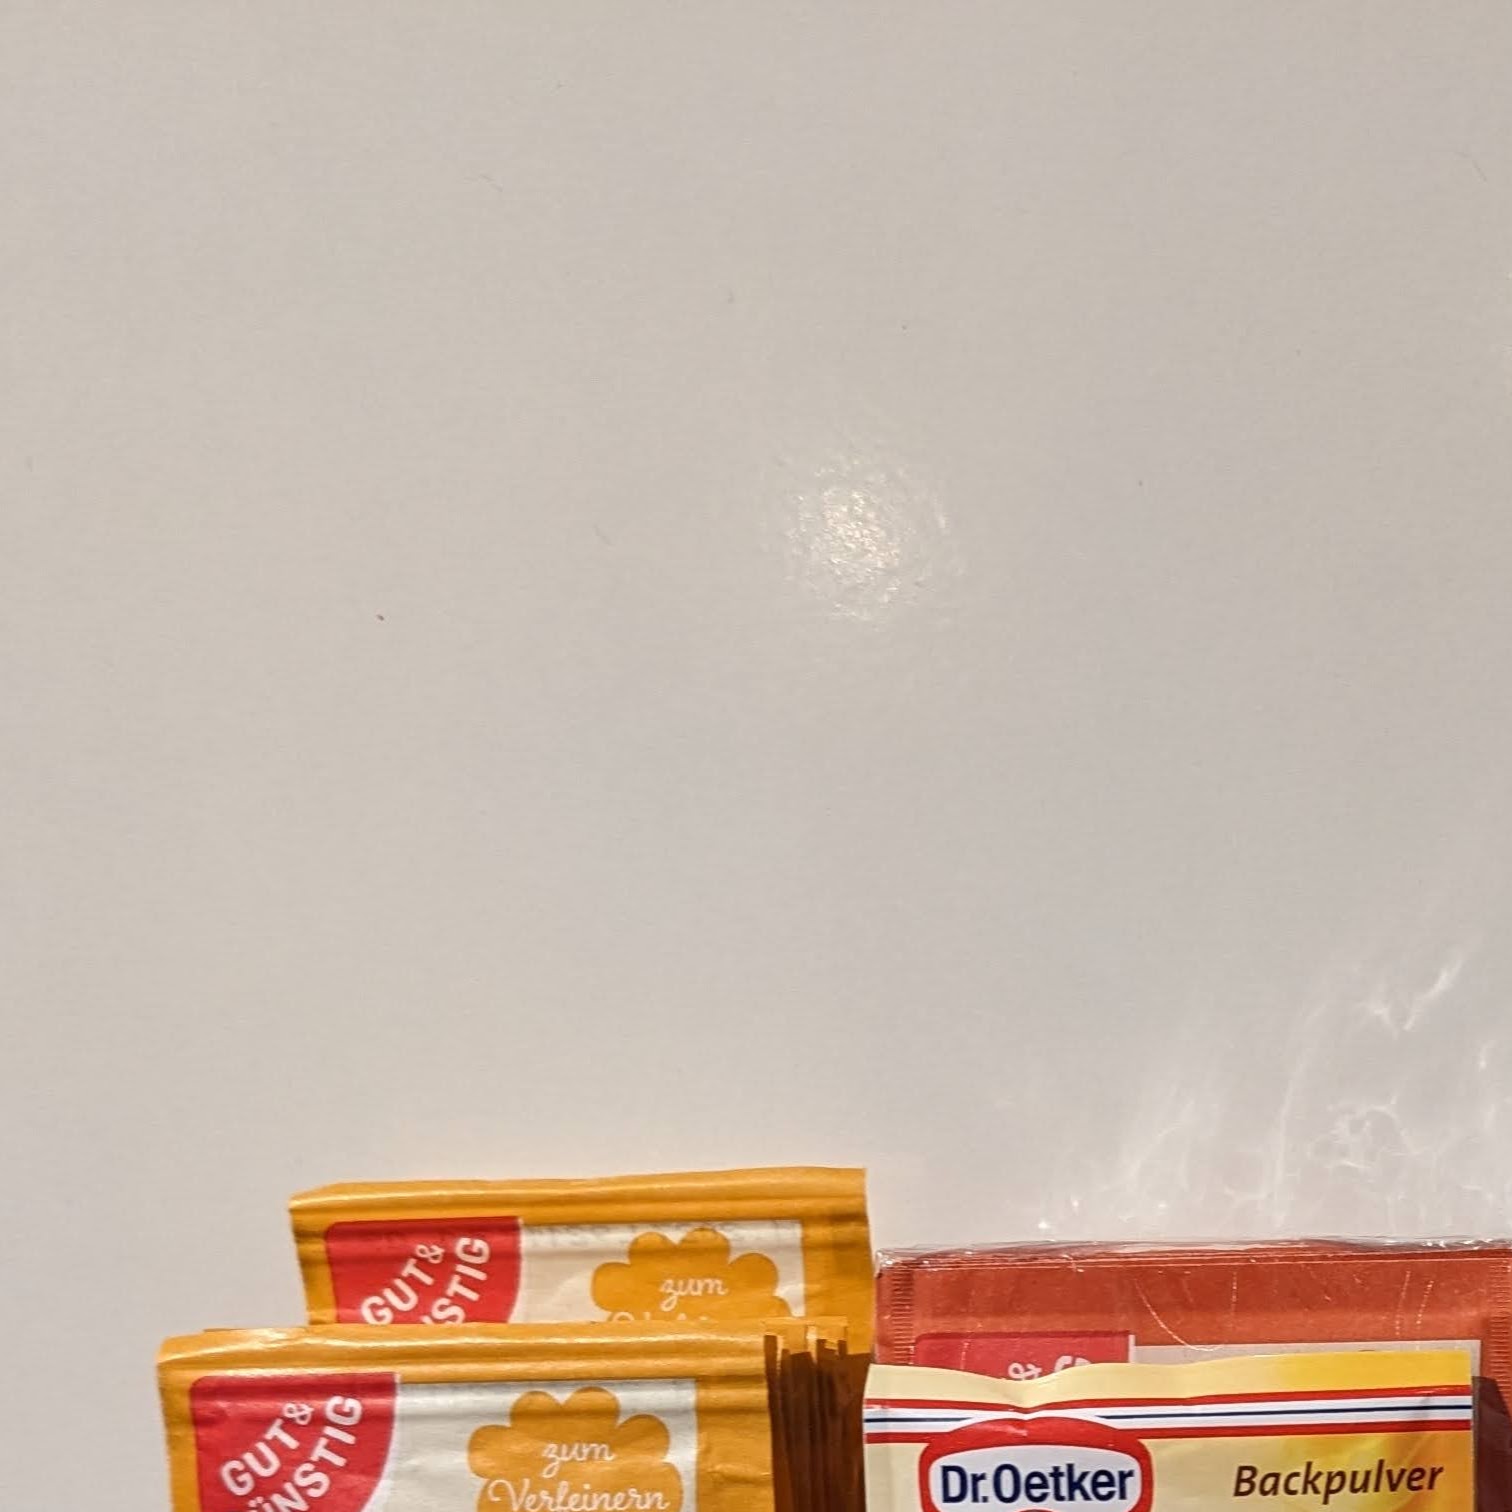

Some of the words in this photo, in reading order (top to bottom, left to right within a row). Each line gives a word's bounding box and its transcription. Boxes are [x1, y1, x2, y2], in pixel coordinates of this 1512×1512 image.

[360, 1258, 435, 1325] GUT
[421, 1237, 490, 1325] STIG
[659, 1277, 728, 1312] zum
[220, 1418, 300, 1497] GUT
[541, 1442, 617, 1478] zum
[1232, 1459, 1444, 1504] Backpulver
